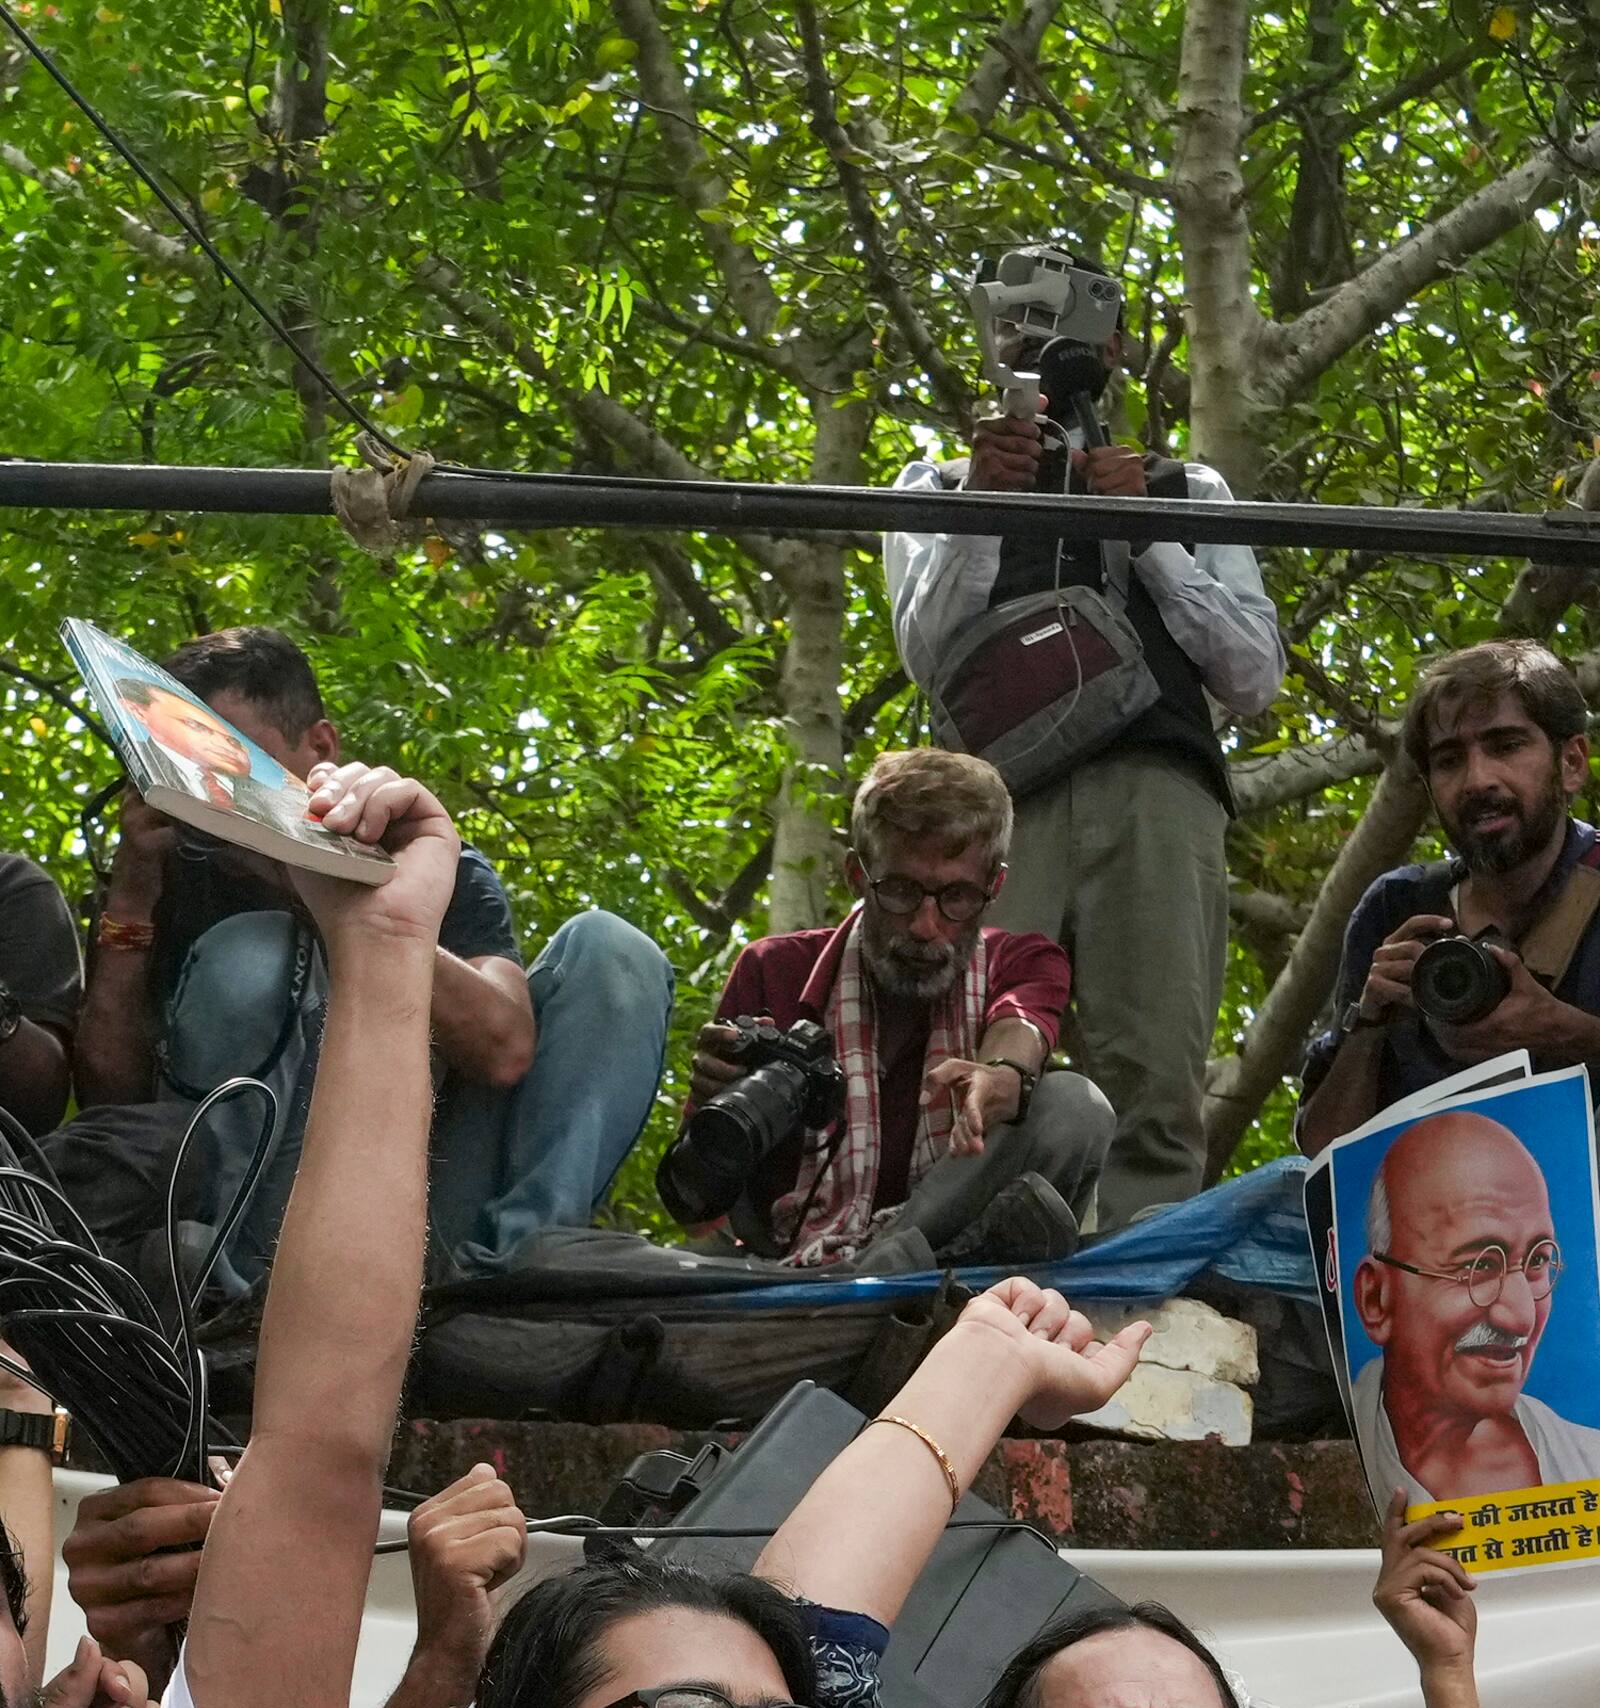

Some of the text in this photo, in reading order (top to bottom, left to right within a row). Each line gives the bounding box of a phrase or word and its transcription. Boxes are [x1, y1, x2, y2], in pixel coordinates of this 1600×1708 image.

[1469, 1503, 1502, 1527] की
[1577, 1489, 1599, 1512] है
[1482, 1537, 1504, 1560] से
[1511, 1527, 1570, 1557] आती
